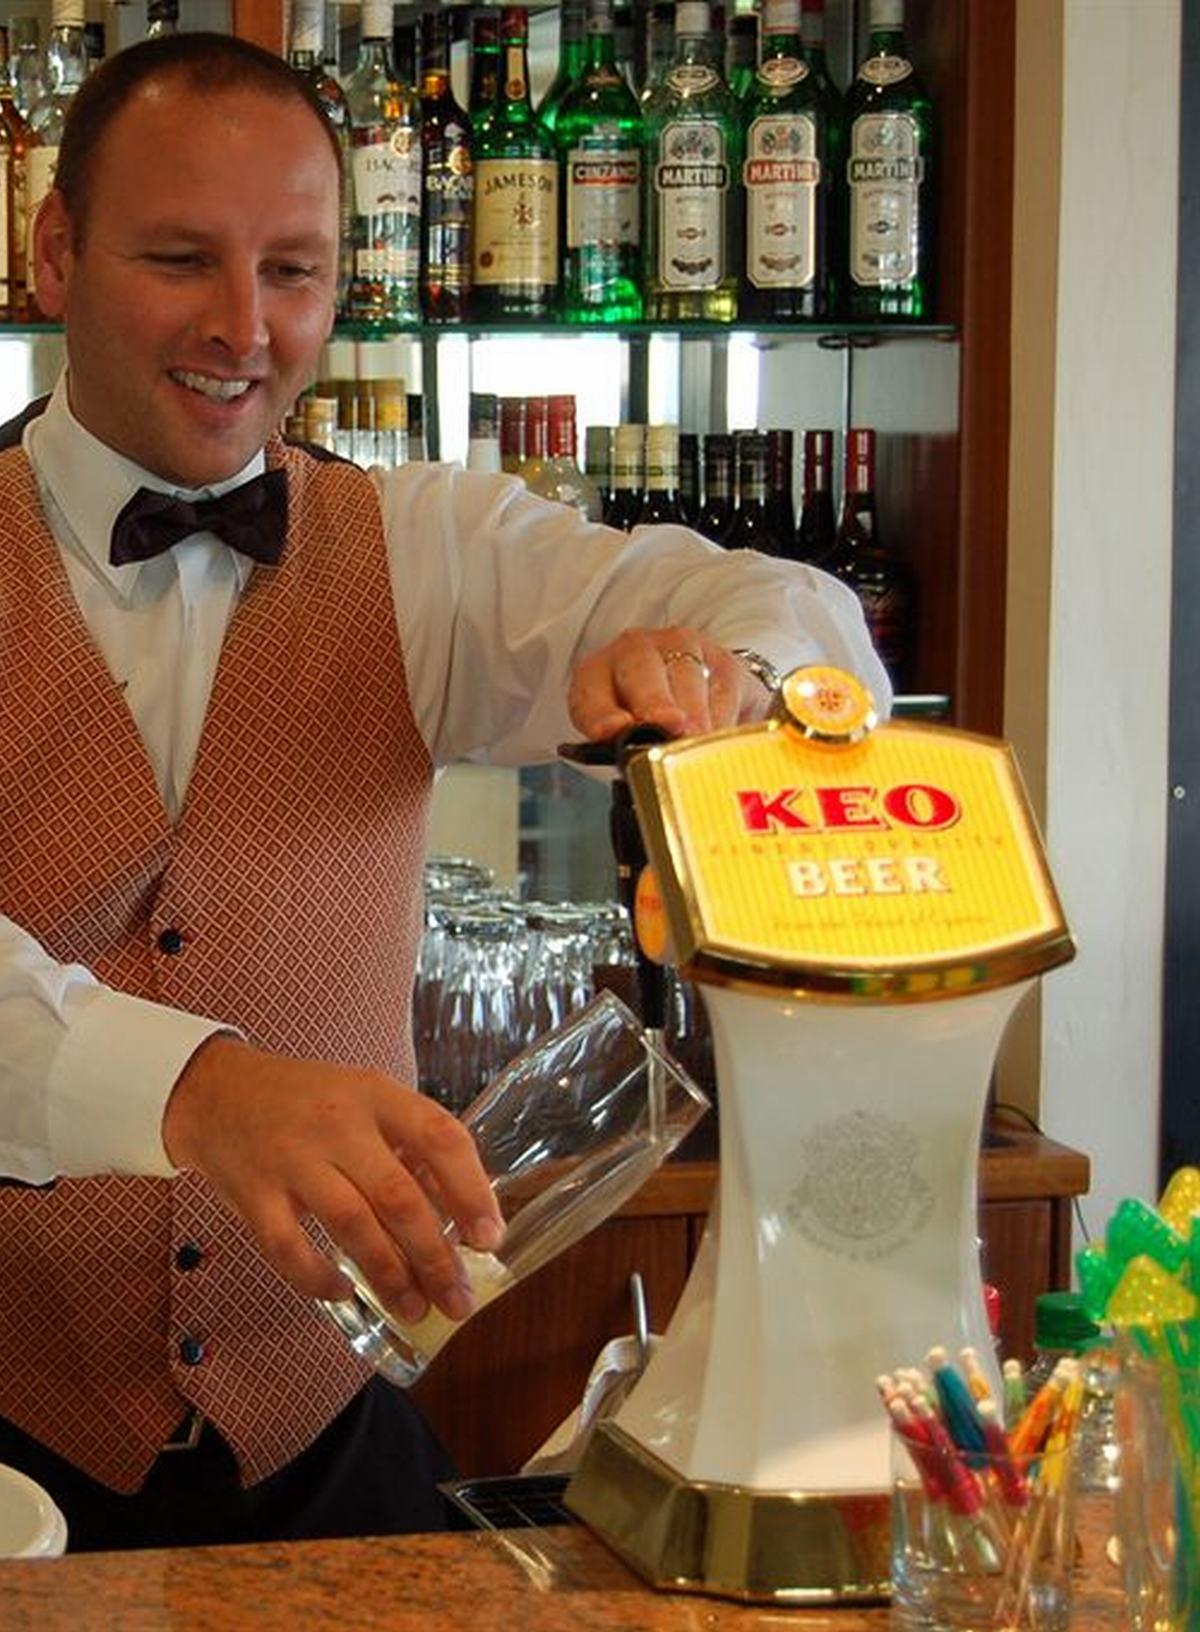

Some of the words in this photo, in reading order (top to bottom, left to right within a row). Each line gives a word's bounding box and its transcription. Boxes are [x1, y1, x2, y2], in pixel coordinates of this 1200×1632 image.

[662, 166, 724, 186] MARTINI
[751, 161, 816, 182] MARTINI
[853, 159, 915, 180] MARTINI
[484, 173, 553, 196] JAMESON
[736, 784, 961, 835] KEO
[787, 857, 951, 898] BEER
